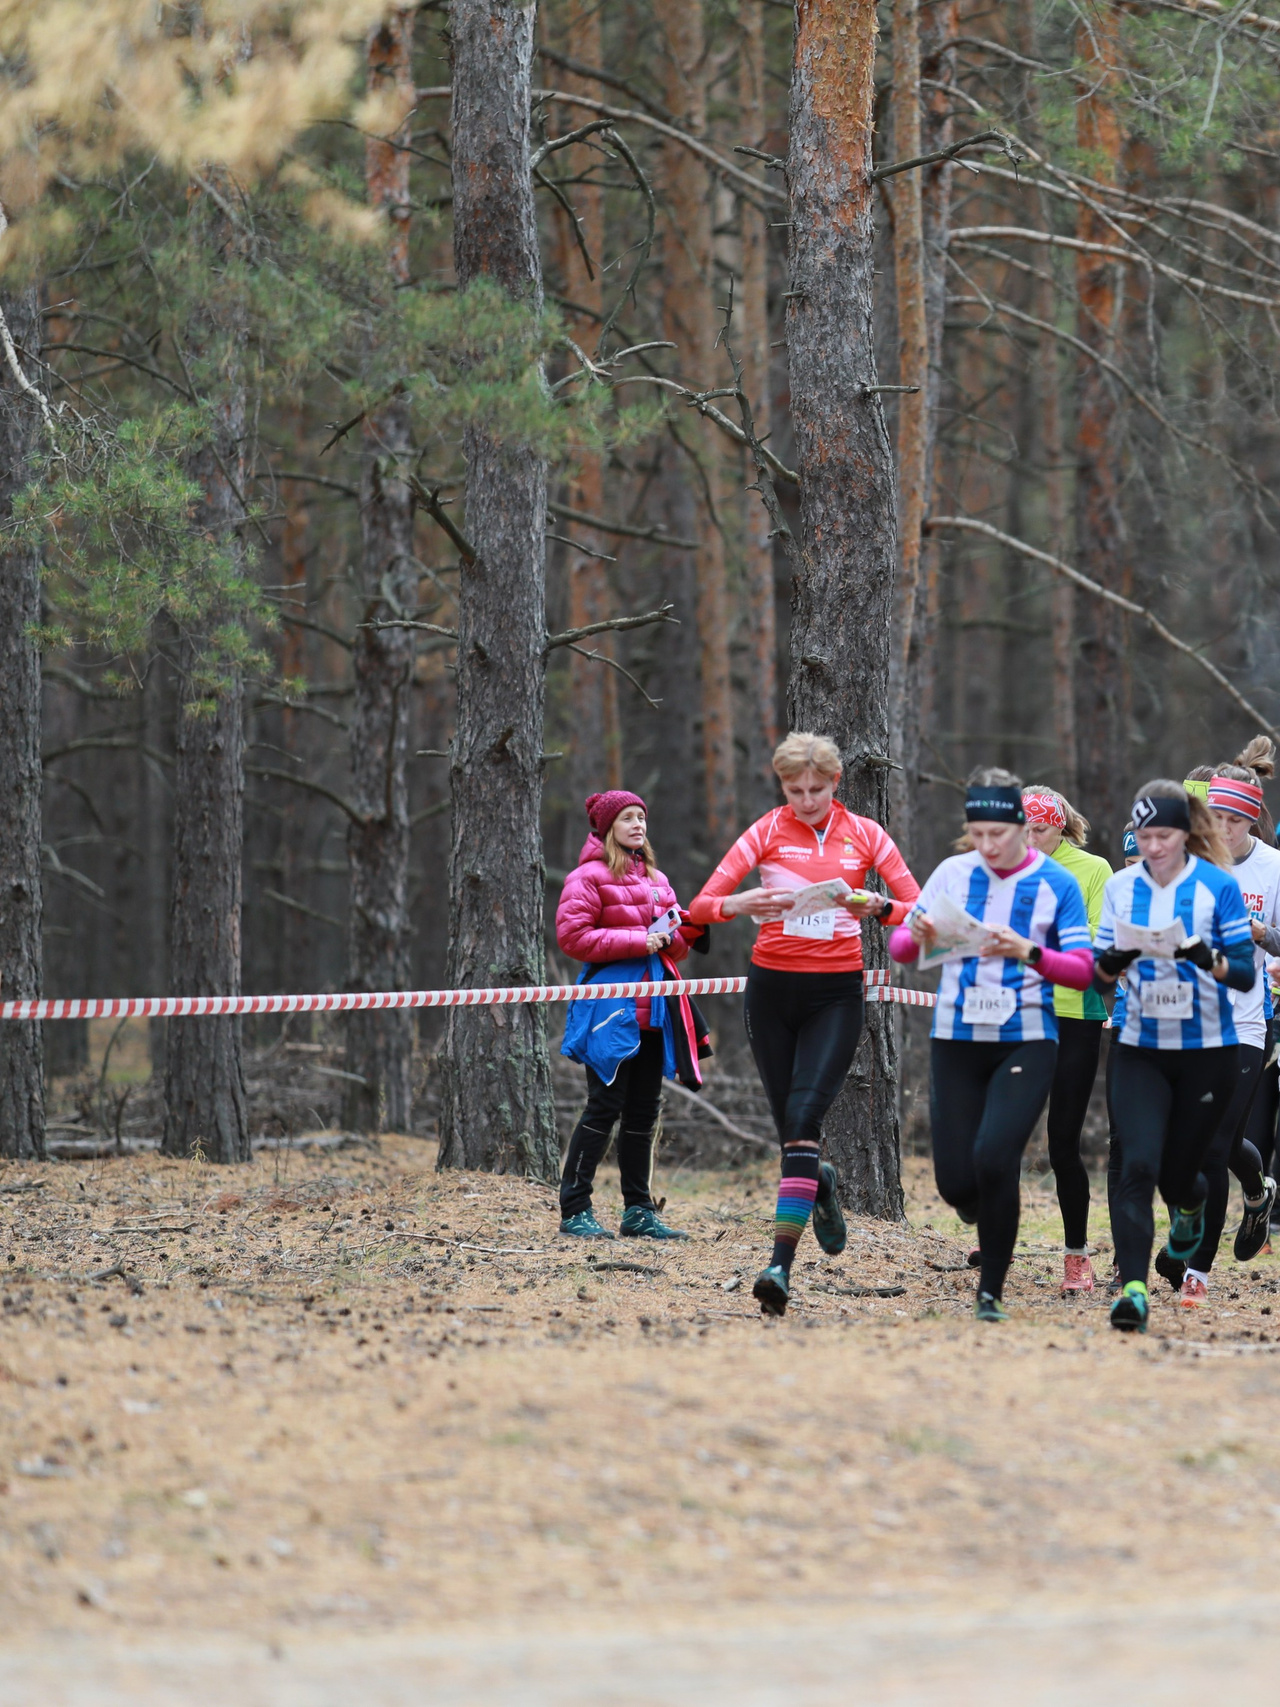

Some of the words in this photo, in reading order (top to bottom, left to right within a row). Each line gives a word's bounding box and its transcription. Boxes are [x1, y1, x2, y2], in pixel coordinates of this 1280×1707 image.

[801, 915, 820, 926] 115
[979, 999, 1000, 1011] 105
[1156, 994, 1177, 1005] 104
